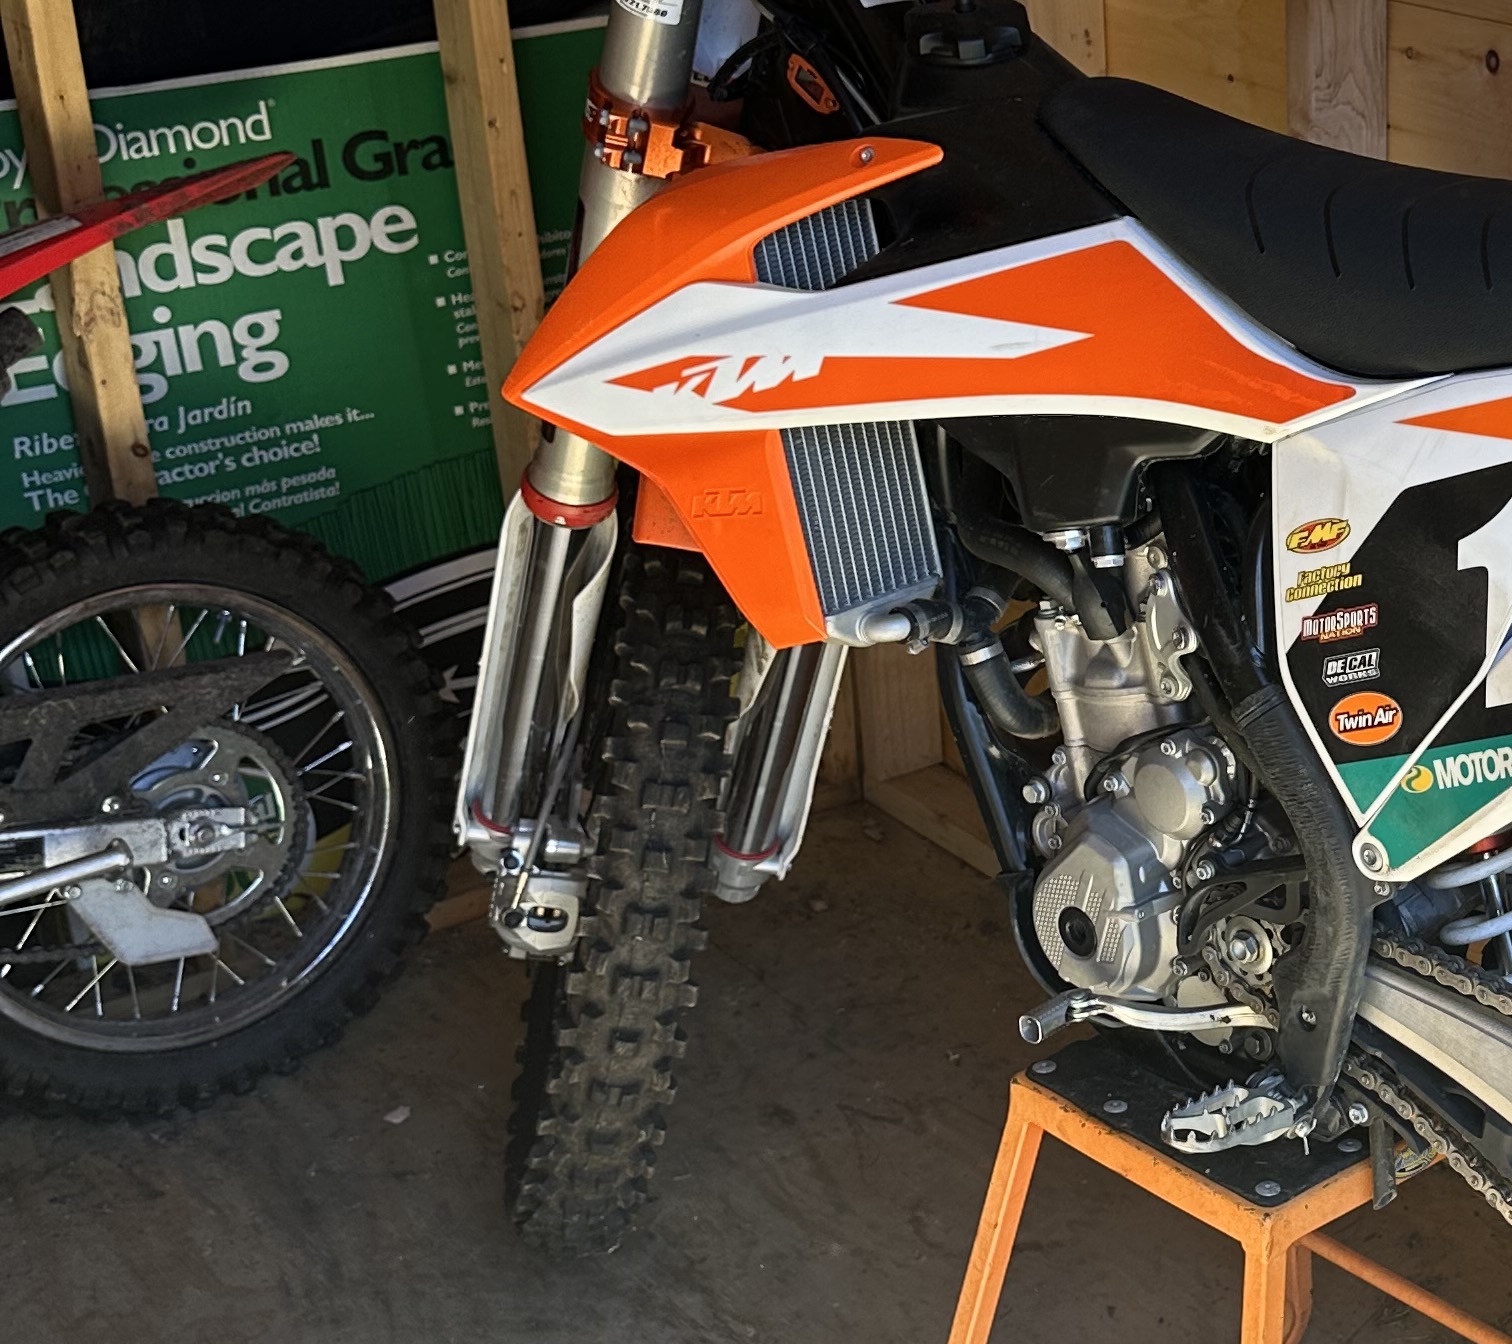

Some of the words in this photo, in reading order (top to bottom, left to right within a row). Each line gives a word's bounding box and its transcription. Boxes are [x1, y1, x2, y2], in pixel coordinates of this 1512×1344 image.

[93, 100, 272, 164] Diamond
[115, 204, 419, 298] ndscape
[648, 353, 825, 404] KTM
[13, 432, 80, 458] Ribe
[178, 396, 252, 433] Jardín
[165, 426, 280, 460] construction
[285, 412, 344, 434] makes
[346, 406, 375, 423] it...
[24, 488, 79, 513] The
[157, 453, 236, 487] actor's
[241, 434, 321, 469] choice!
[281, 466, 336, 492] pesada
[249, 483, 340, 513] Contratista!
[691, 488, 763, 518] KTM
[1287, 520, 1349, 550] FMF
[1285, 574, 1363, 603] Connection
[1297, 562, 1351, 587] Factory
[1319, 626, 1362, 641] NATION
[1325, 668, 1379, 685] WORKS
[1336, 710, 1373, 732] Twin
[1374, 705, 1398, 725] Air
